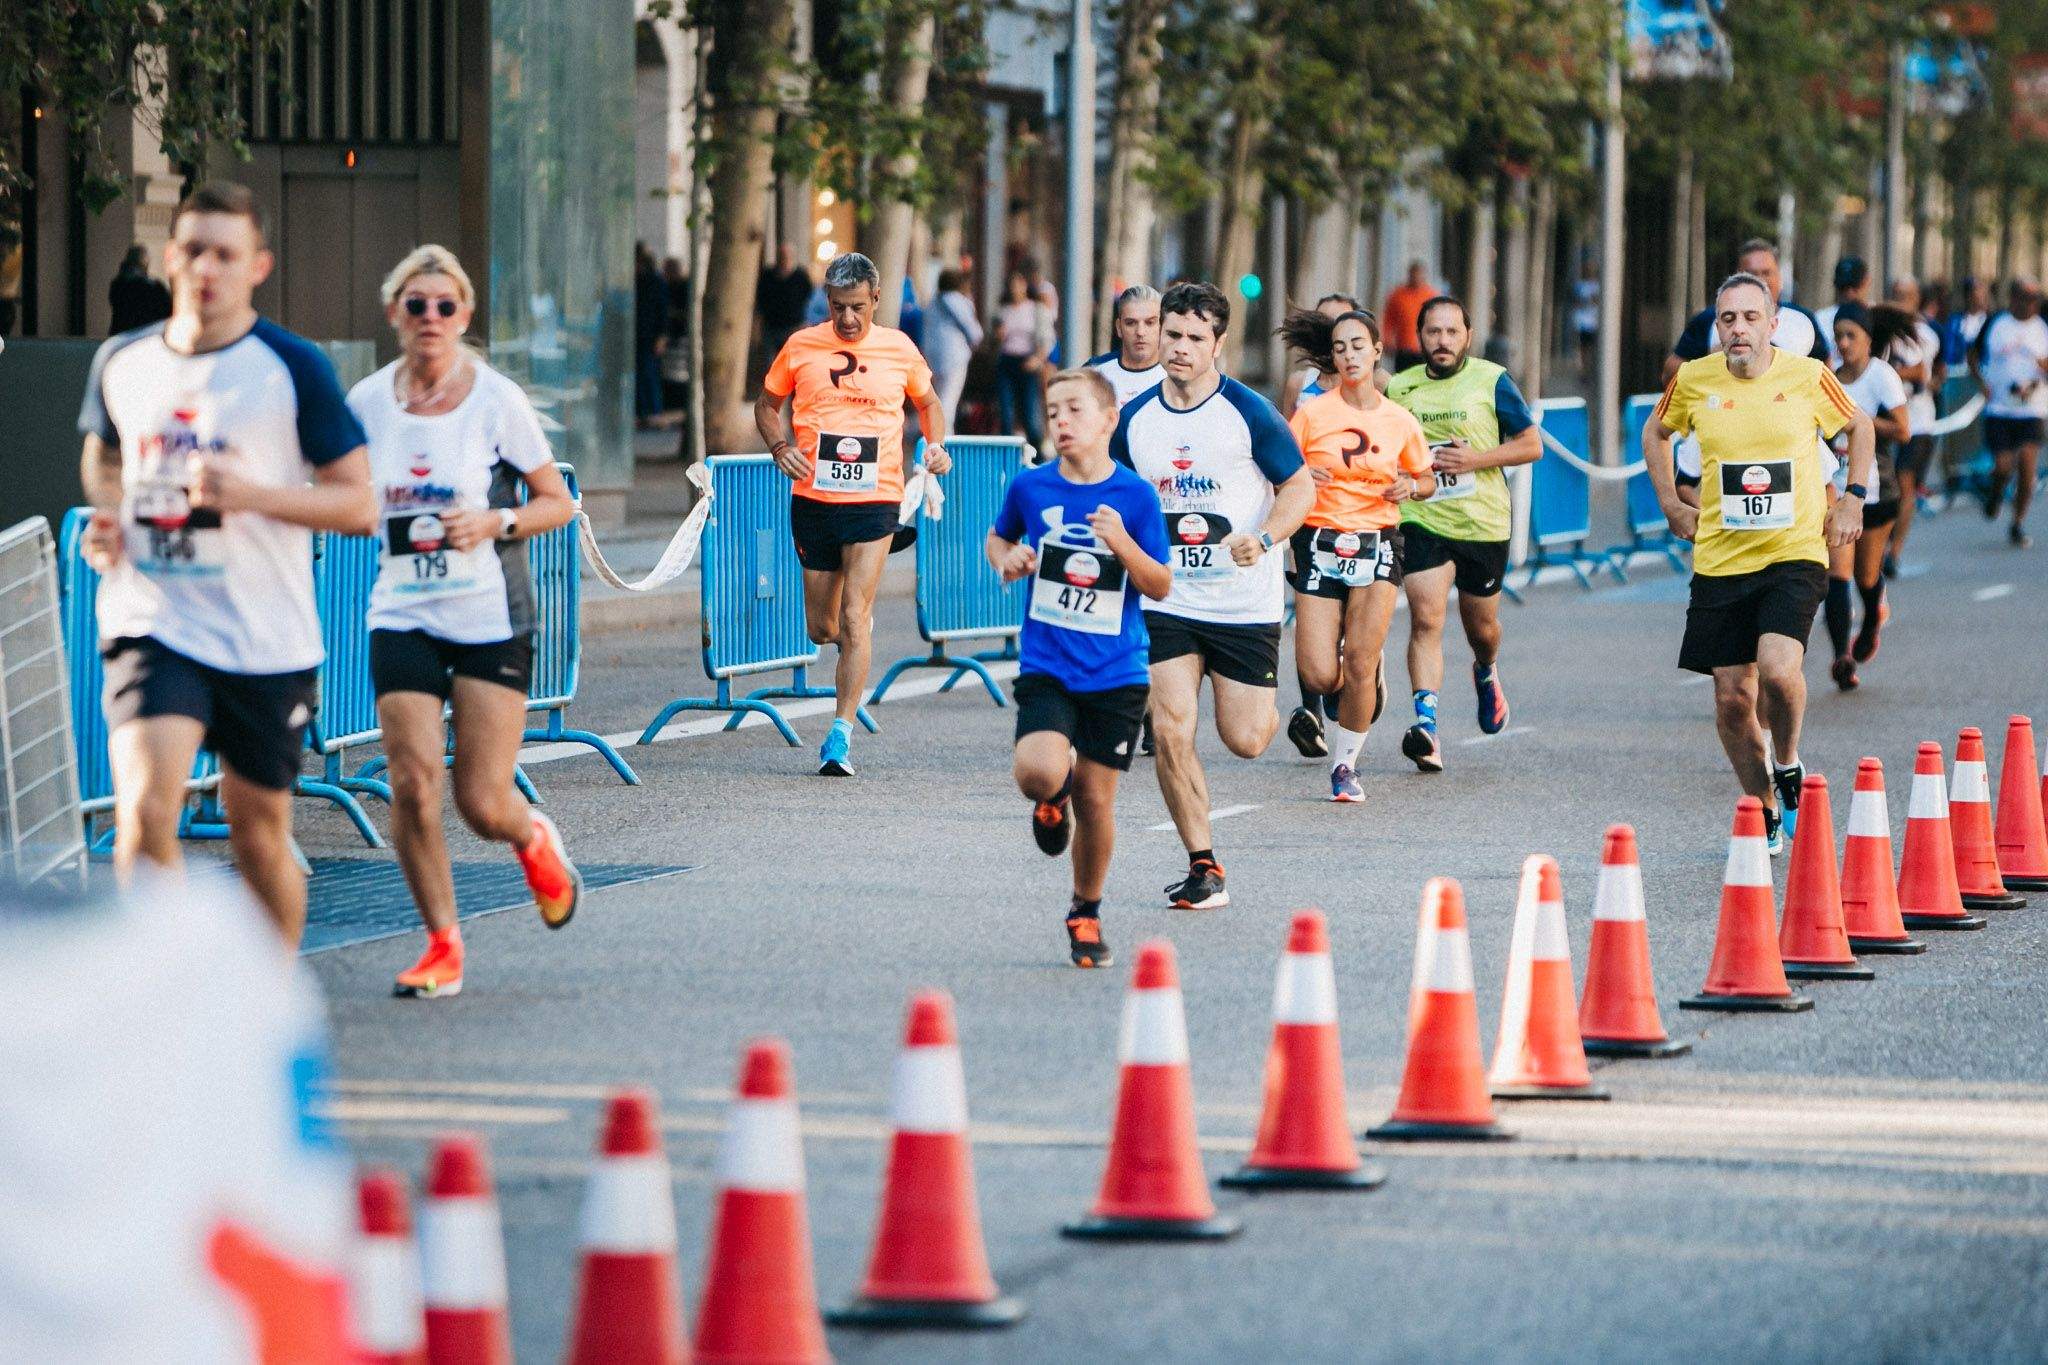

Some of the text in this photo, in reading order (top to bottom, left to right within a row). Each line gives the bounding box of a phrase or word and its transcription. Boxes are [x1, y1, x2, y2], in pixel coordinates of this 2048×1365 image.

[1421, 410, 1467, 423] Running
[831, 462, 863, 481] 539
[1742, 495, 1773, 516] 167
[413, 554, 448, 579] 179
[1178, 546, 1212, 568] 152
[1058, 588, 1097, 614] 472
